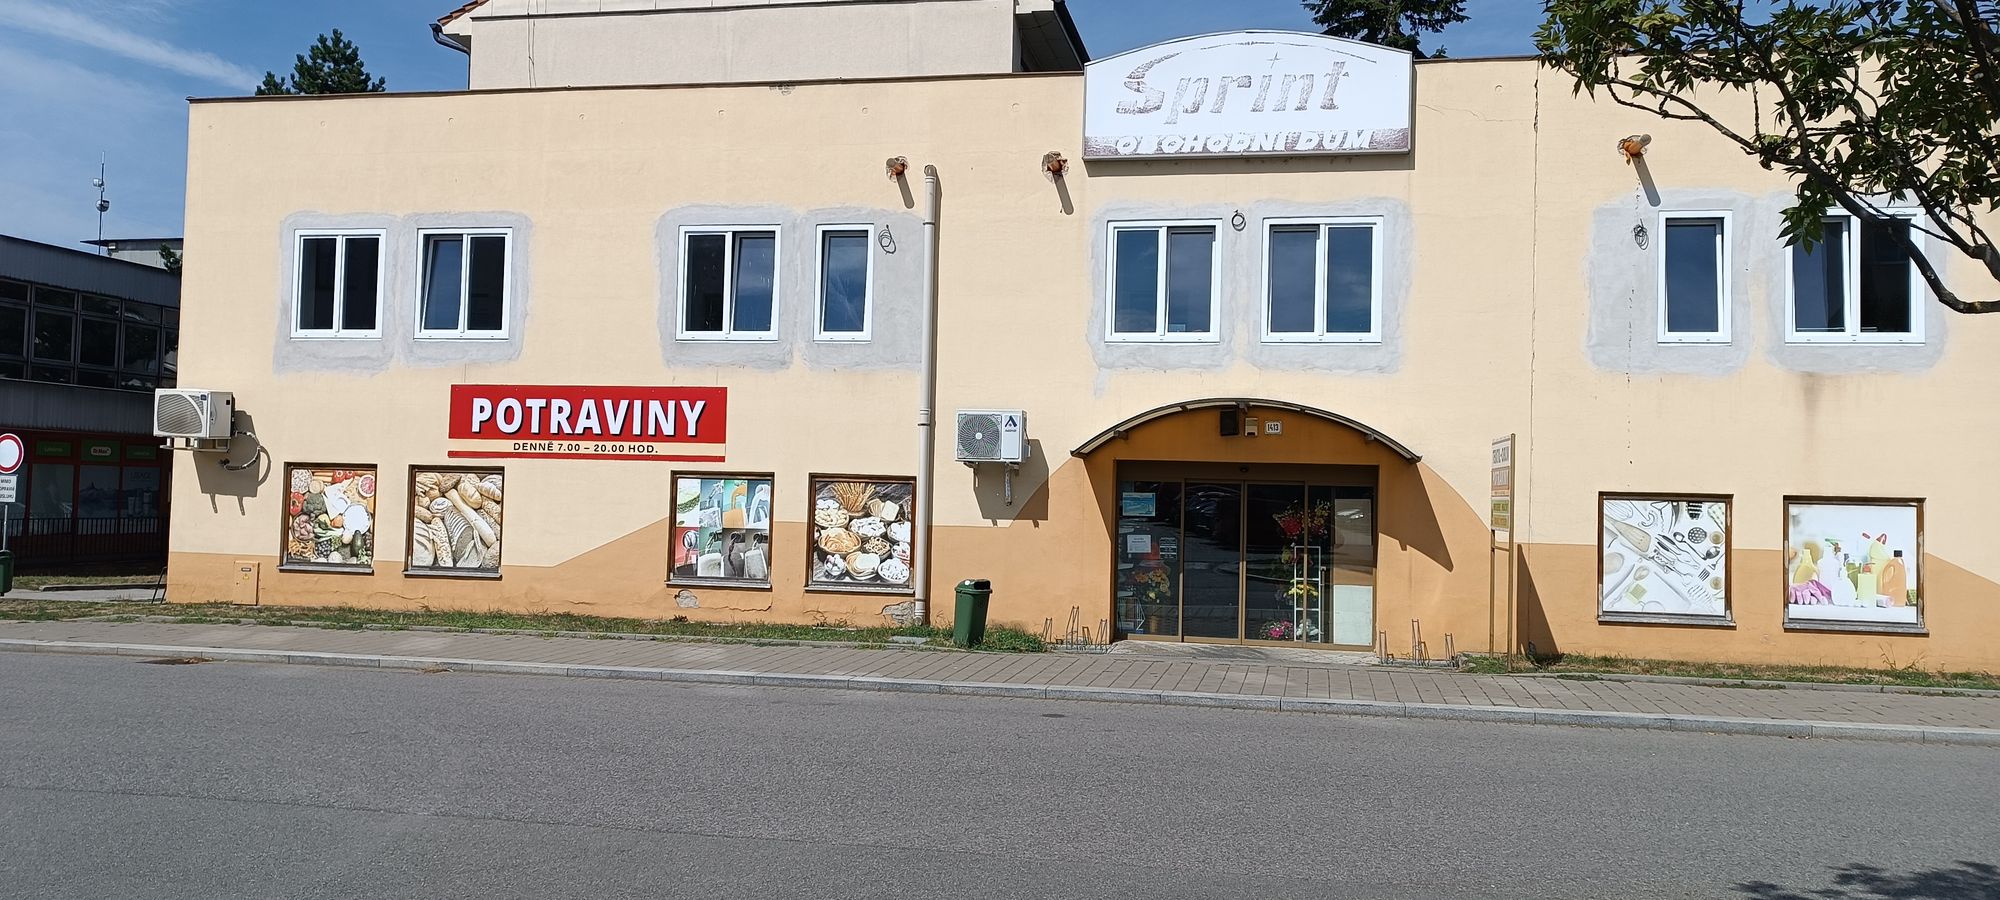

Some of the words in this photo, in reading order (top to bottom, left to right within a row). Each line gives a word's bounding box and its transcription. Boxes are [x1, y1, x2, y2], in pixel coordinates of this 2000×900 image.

[1116, 52, 1349, 124] Sprint
[472, 397, 706, 436] POTRAVINY
[1267, 423, 1278, 431] 1413
[513, 441, 554, 451] DENNĚ
[557, 443, 580, 451] 7.00
[594, 444, 625, 453] 20.00
[628, 444, 658, 453] HOD.
